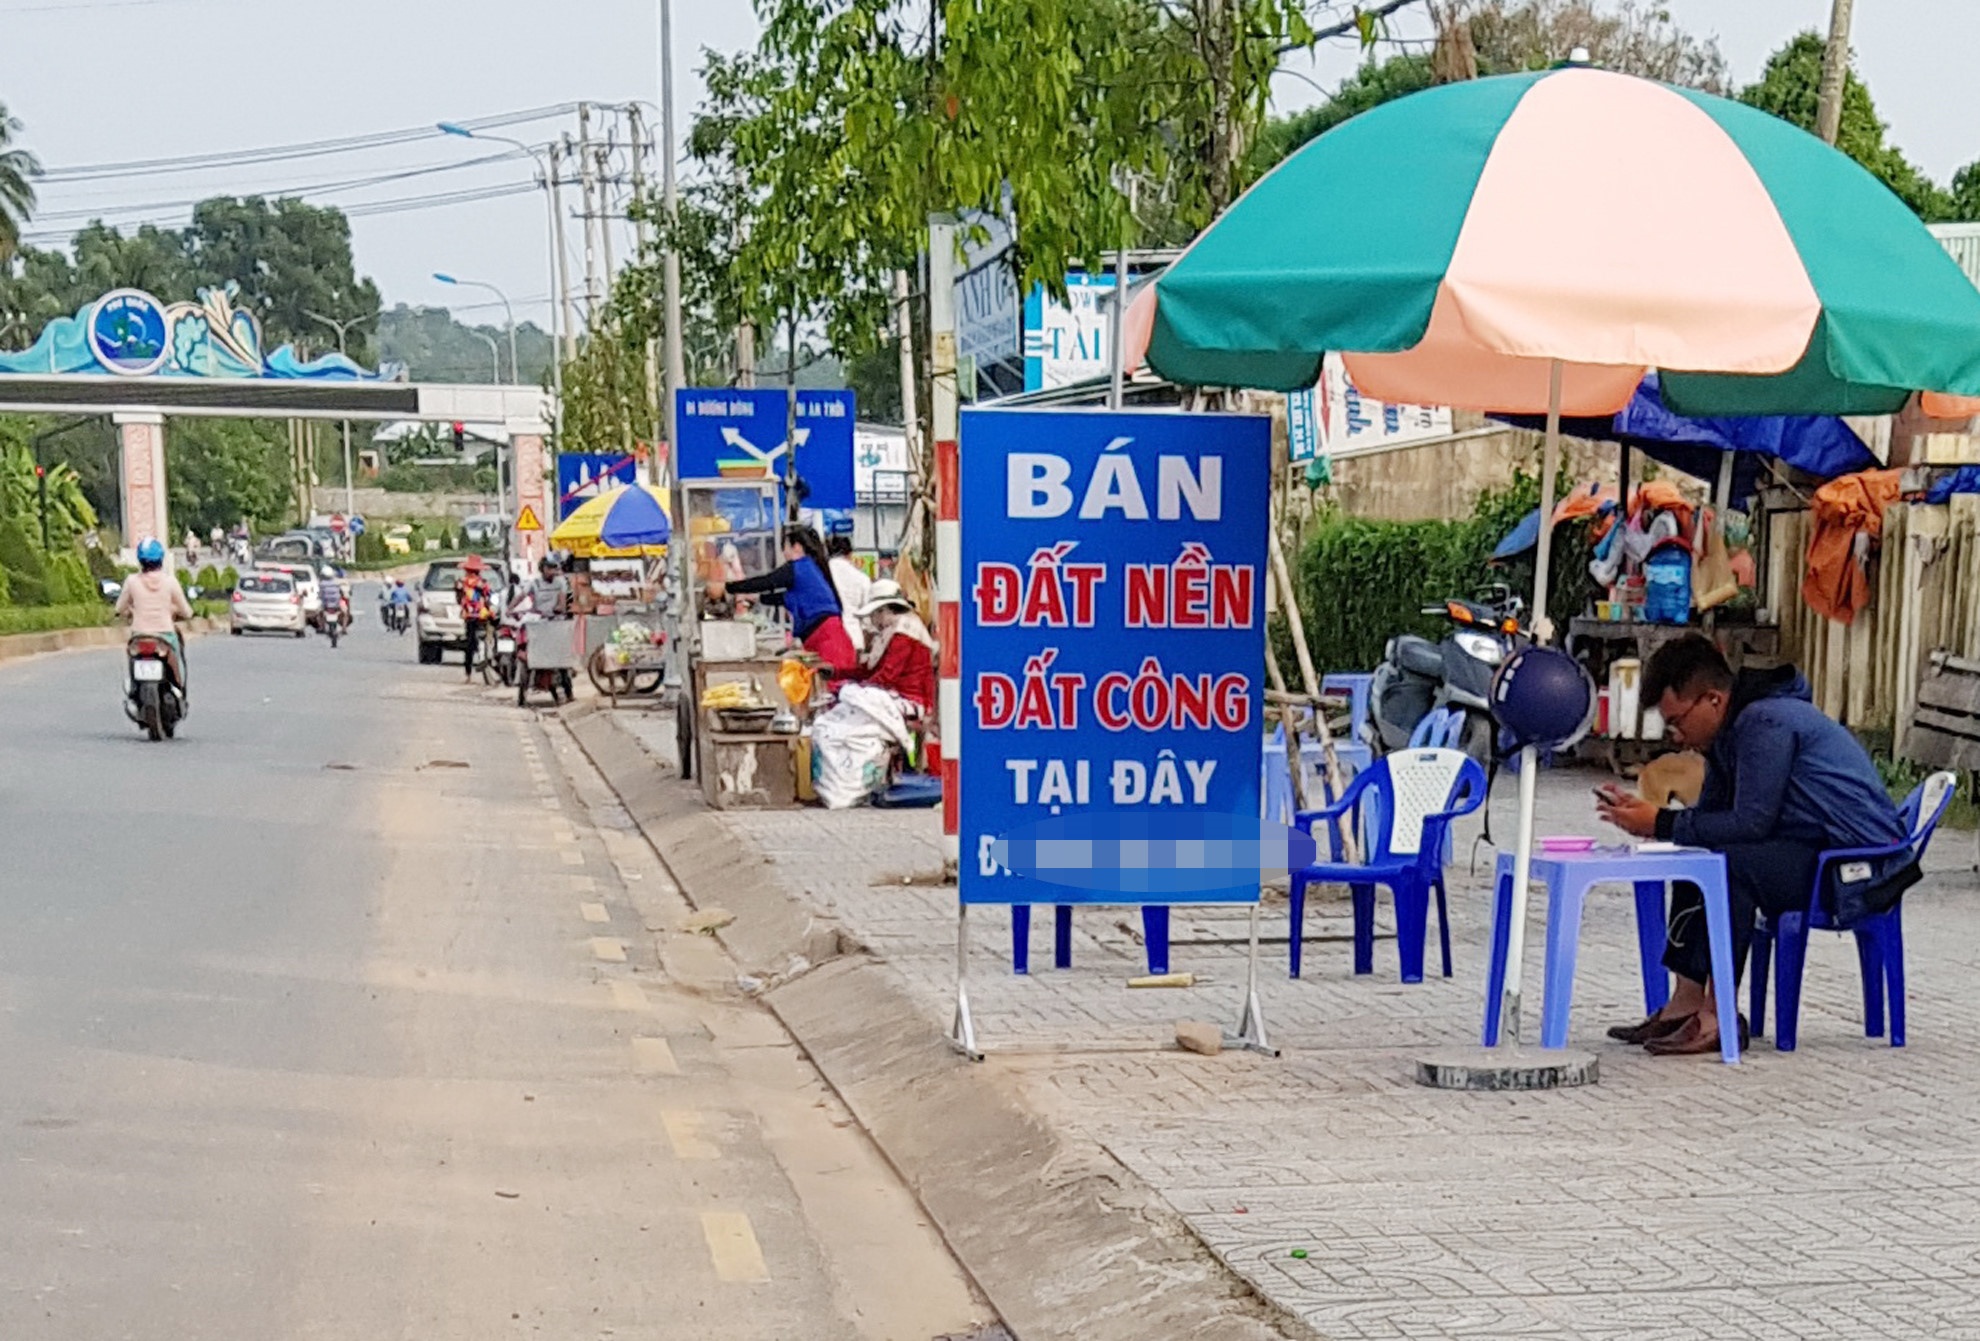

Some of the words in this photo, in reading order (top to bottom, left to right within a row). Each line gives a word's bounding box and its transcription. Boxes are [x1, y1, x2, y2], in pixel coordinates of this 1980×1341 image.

[1007, 437, 1222, 519] BÁN
[973, 541, 1107, 628] ĐẤT
[1124, 542, 1255, 629] NỀN
[973, 648, 1087, 730] ĐẤT
[1094, 657, 1250, 732] CÔNG
[1005, 759, 1090, 815] TẠI
[1109, 749, 1217, 804] ĐÂY
